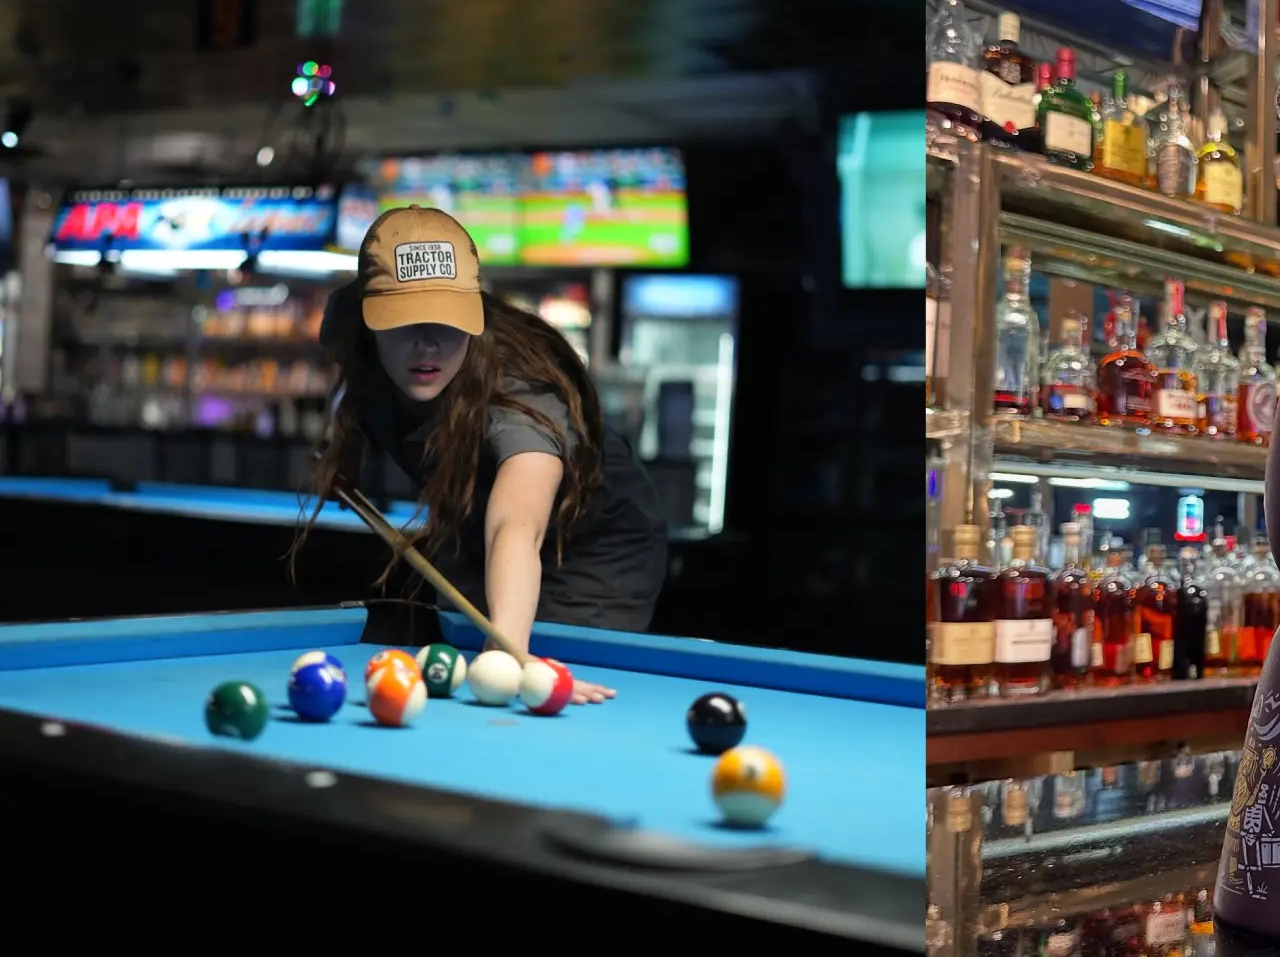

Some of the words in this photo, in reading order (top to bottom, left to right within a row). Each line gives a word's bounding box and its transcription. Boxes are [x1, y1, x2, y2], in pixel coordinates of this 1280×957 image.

[57, 203, 144, 241] APA
[409, 244, 426, 252] SINCE
[398, 251, 453, 266] TRACTOR
[399, 263, 437, 280] SUPPLY
[439, 263, 455, 277] CO.
